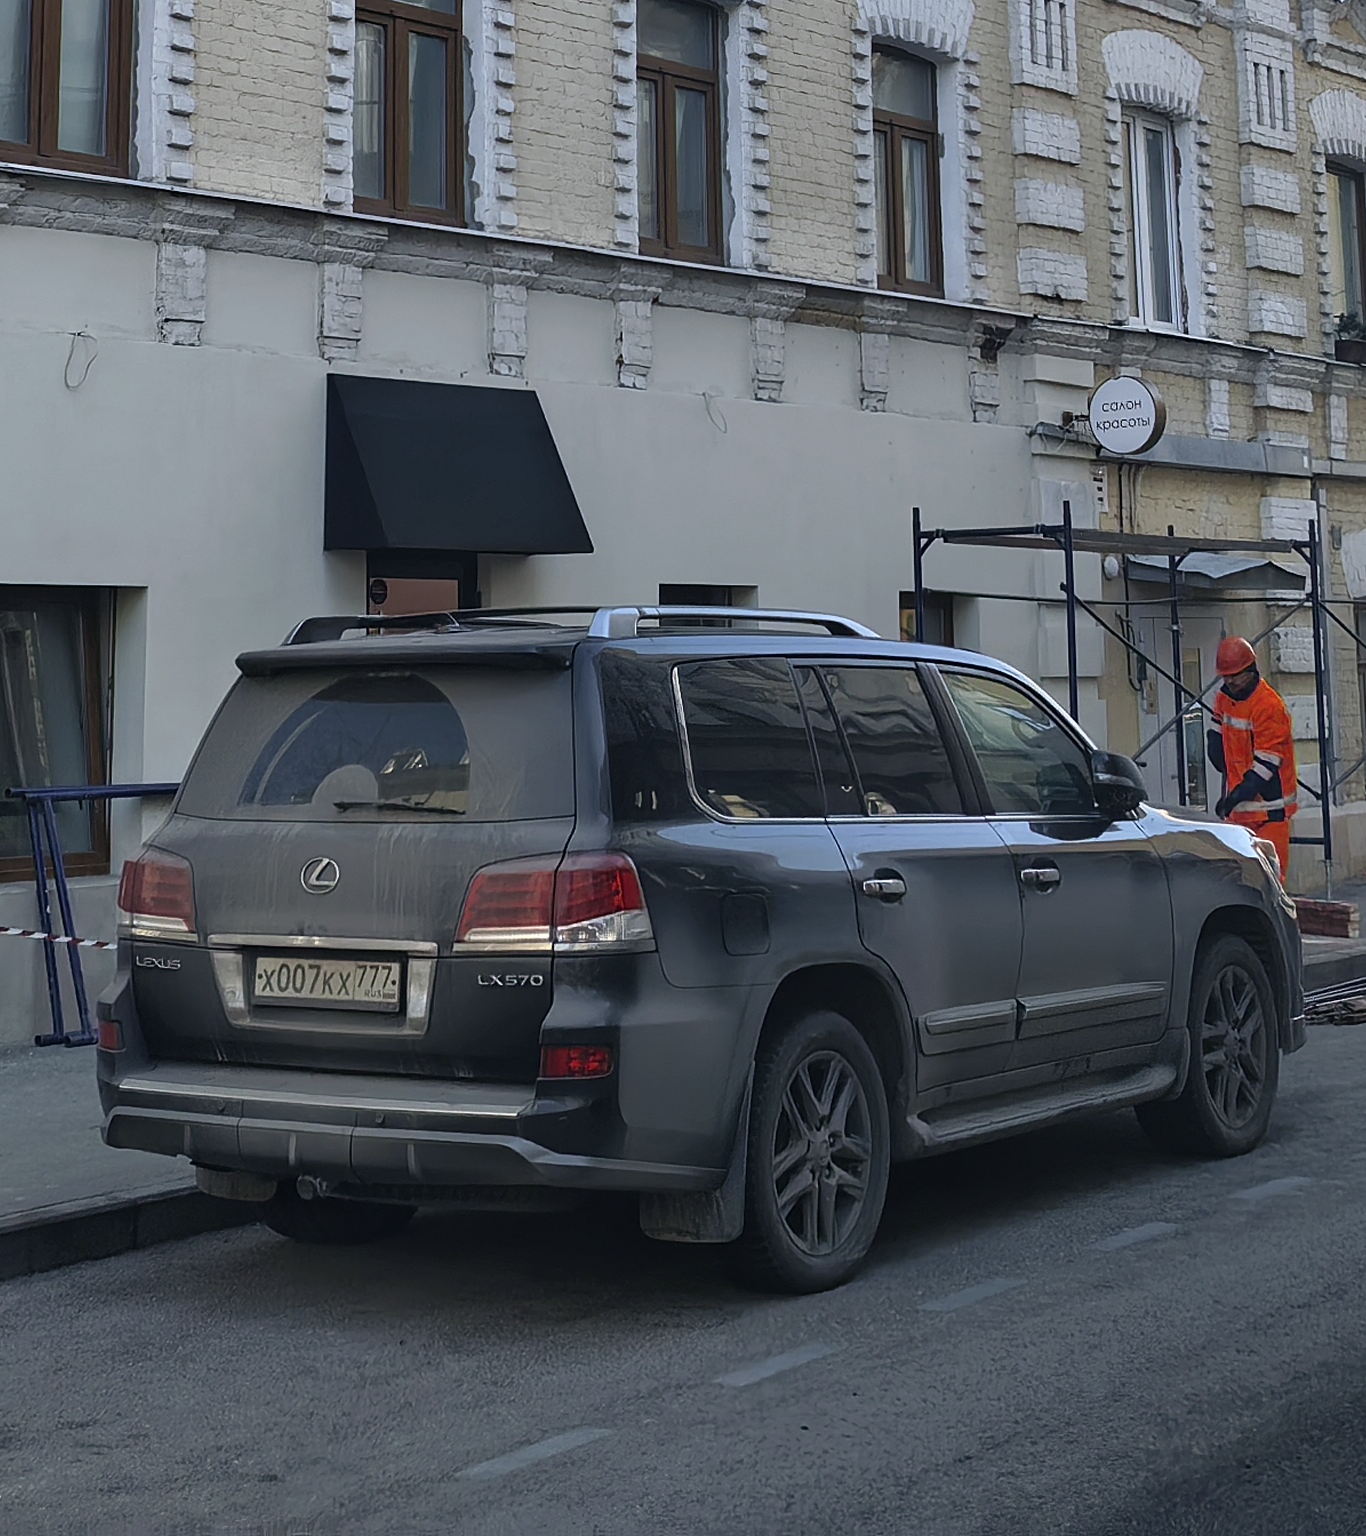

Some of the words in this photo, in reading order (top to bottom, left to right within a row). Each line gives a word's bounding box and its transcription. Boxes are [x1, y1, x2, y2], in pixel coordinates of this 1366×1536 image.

[1101, 399, 1142, 412] салон
[1096, 416, 1150, 433] красоты
[136, 955, 181, 970] LEXUS
